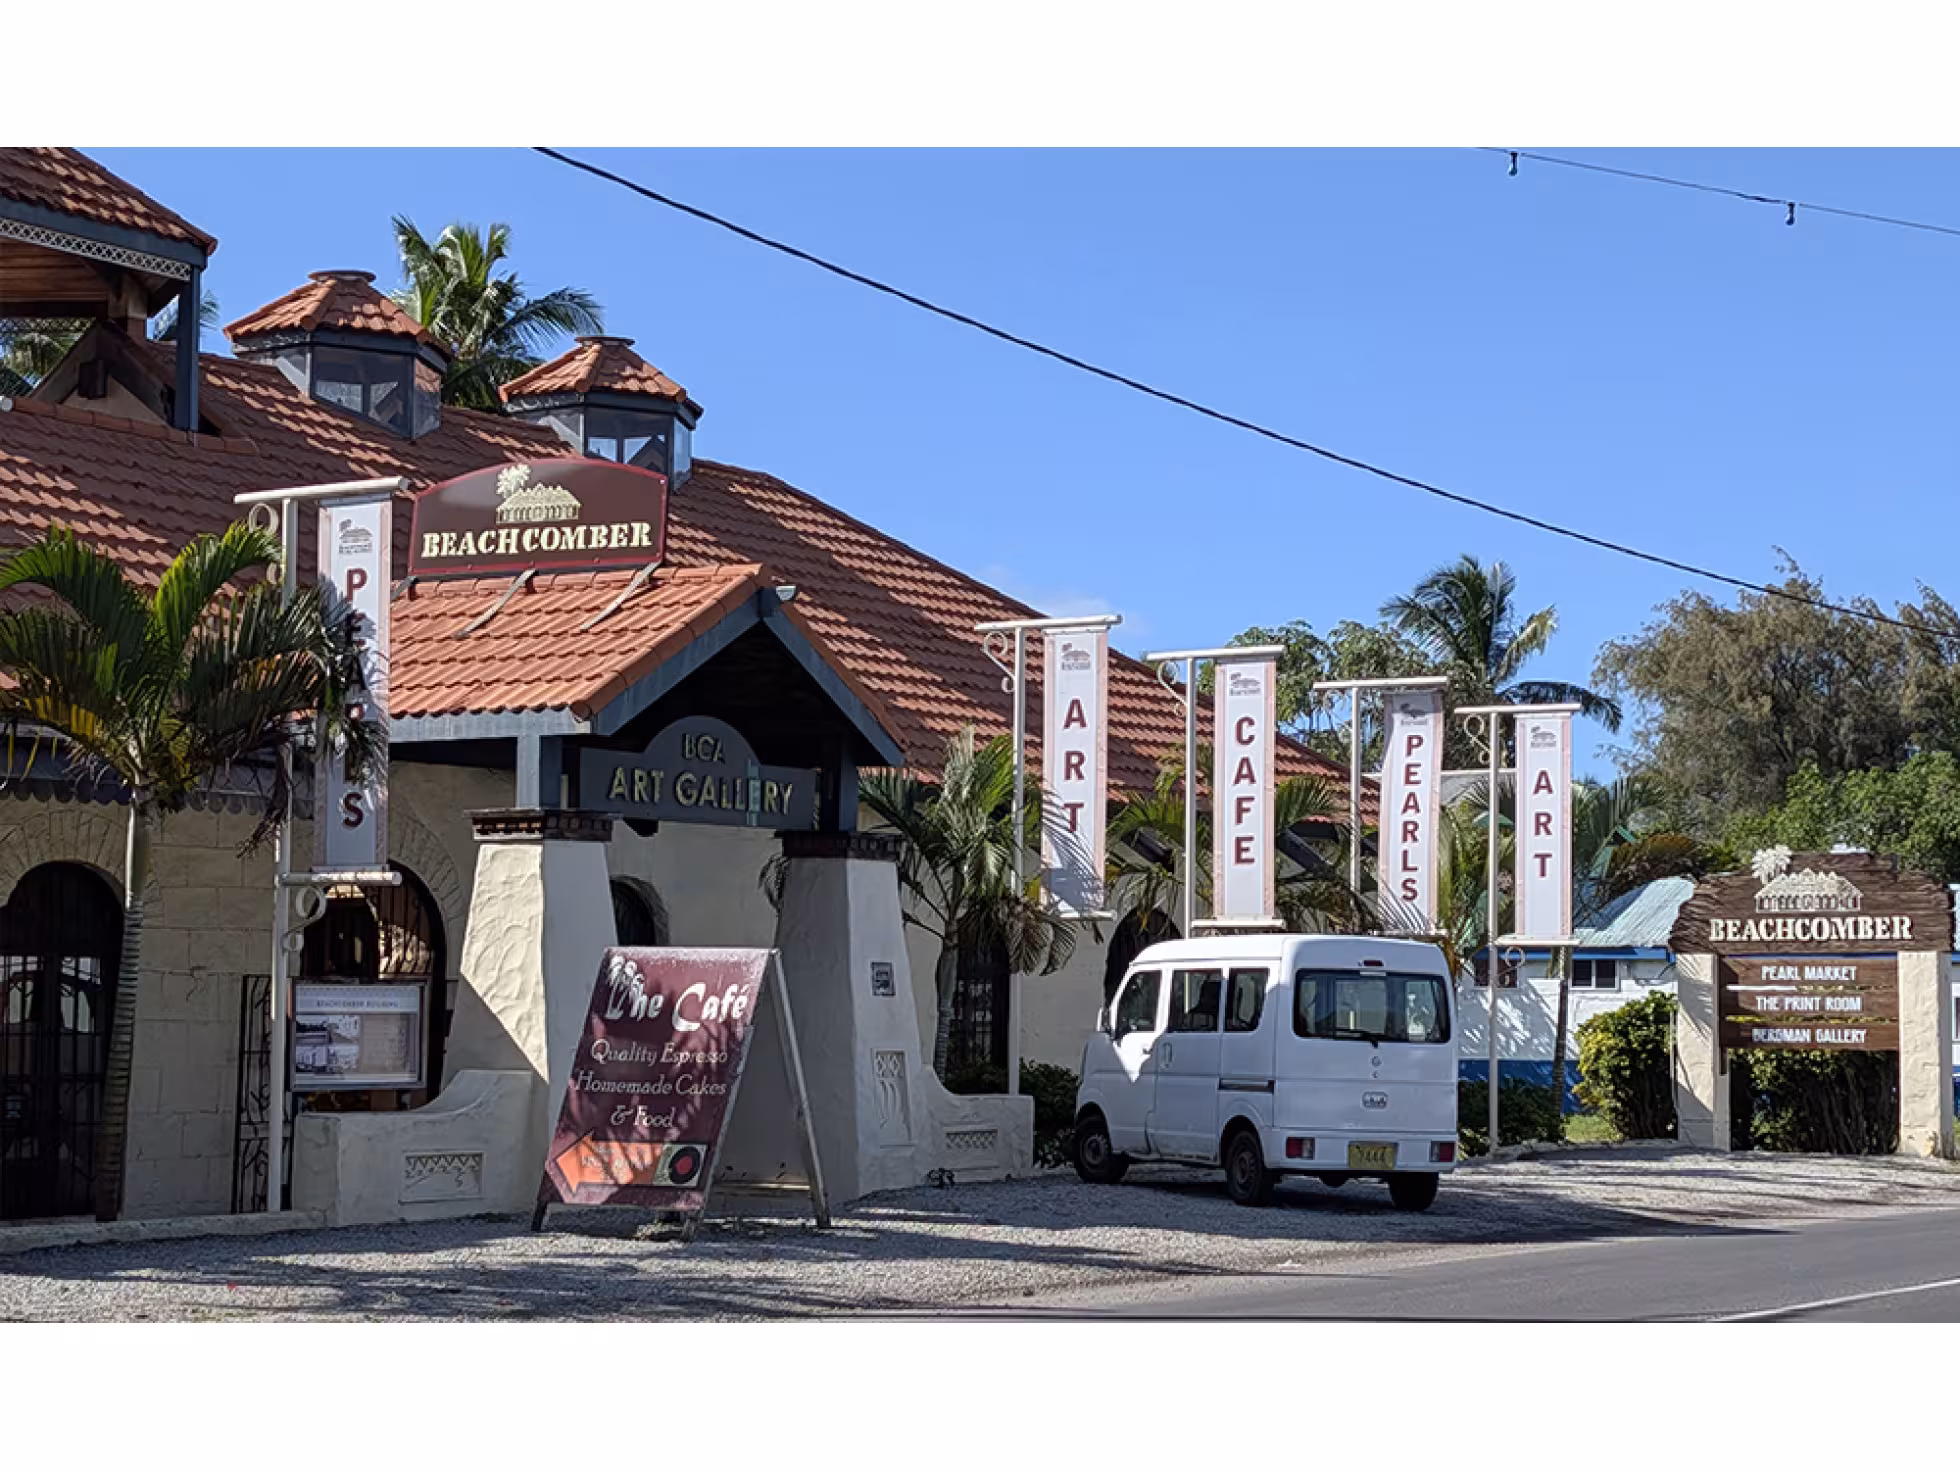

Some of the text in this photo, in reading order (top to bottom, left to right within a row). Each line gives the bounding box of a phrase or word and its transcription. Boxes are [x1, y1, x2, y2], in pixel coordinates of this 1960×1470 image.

[421, 522, 652, 558] BEACHCOMBER
[1063, 699, 1087, 833] ART
[609, 766, 794, 816] ART GALLERY
[1233, 716, 1257, 865] CAFE
[1401, 735, 1424, 901] PEARLS
[1532, 770, 1554, 878] ART
[1709, 915, 1913, 942] BEACHCOMBER
[1761, 965, 1857, 981] PEARL MARKET
[604, 956, 750, 1032] The Café
[1756, 996, 1862, 1012] THE PRINT ROOM
[1815, 1028, 1867, 1043] GALLERY
[591, 1038, 728, 1067] Quality Espresso
[574, 1070, 727, 1096] Homemade Cakes
[610, 1105, 676, 1127] & Food
